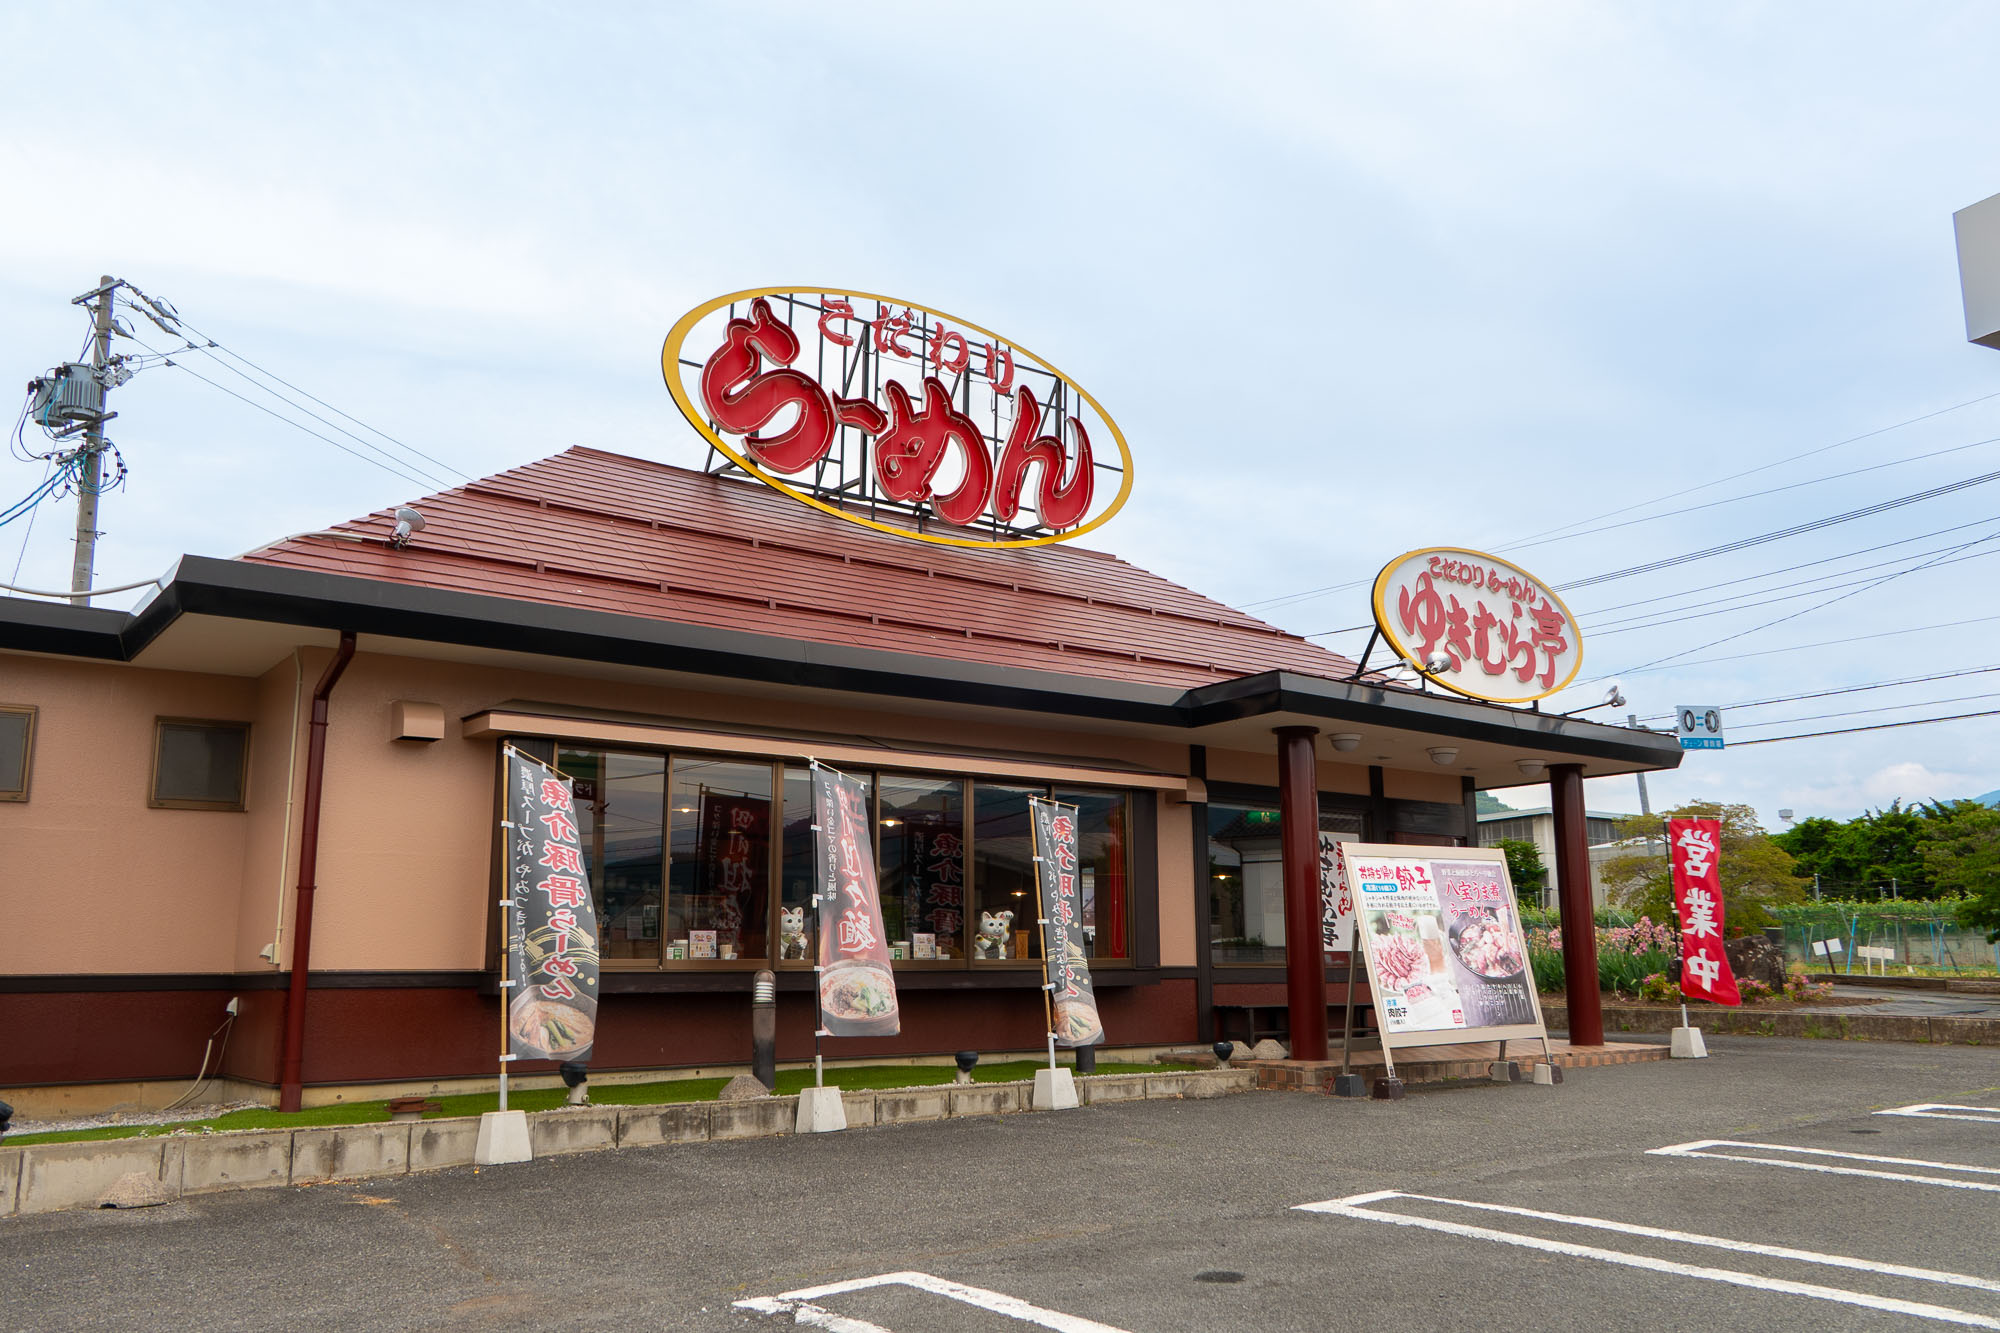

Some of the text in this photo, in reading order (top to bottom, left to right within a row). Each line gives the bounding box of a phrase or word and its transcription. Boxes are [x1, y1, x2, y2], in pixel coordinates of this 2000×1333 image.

[818, 299, 1015, 394] こだわり
[699, 298, 1095, 530] らーめん
[1428, 555, 1536, 603] こだわり らーめん
[1397, 571, 1568, 690] ゆきむら亭
[1446, 880, 1502, 903] 八宝うま煮
[1450, 903, 1490, 920] らーめん
[1677, 828, 1721, 994] 営業中
